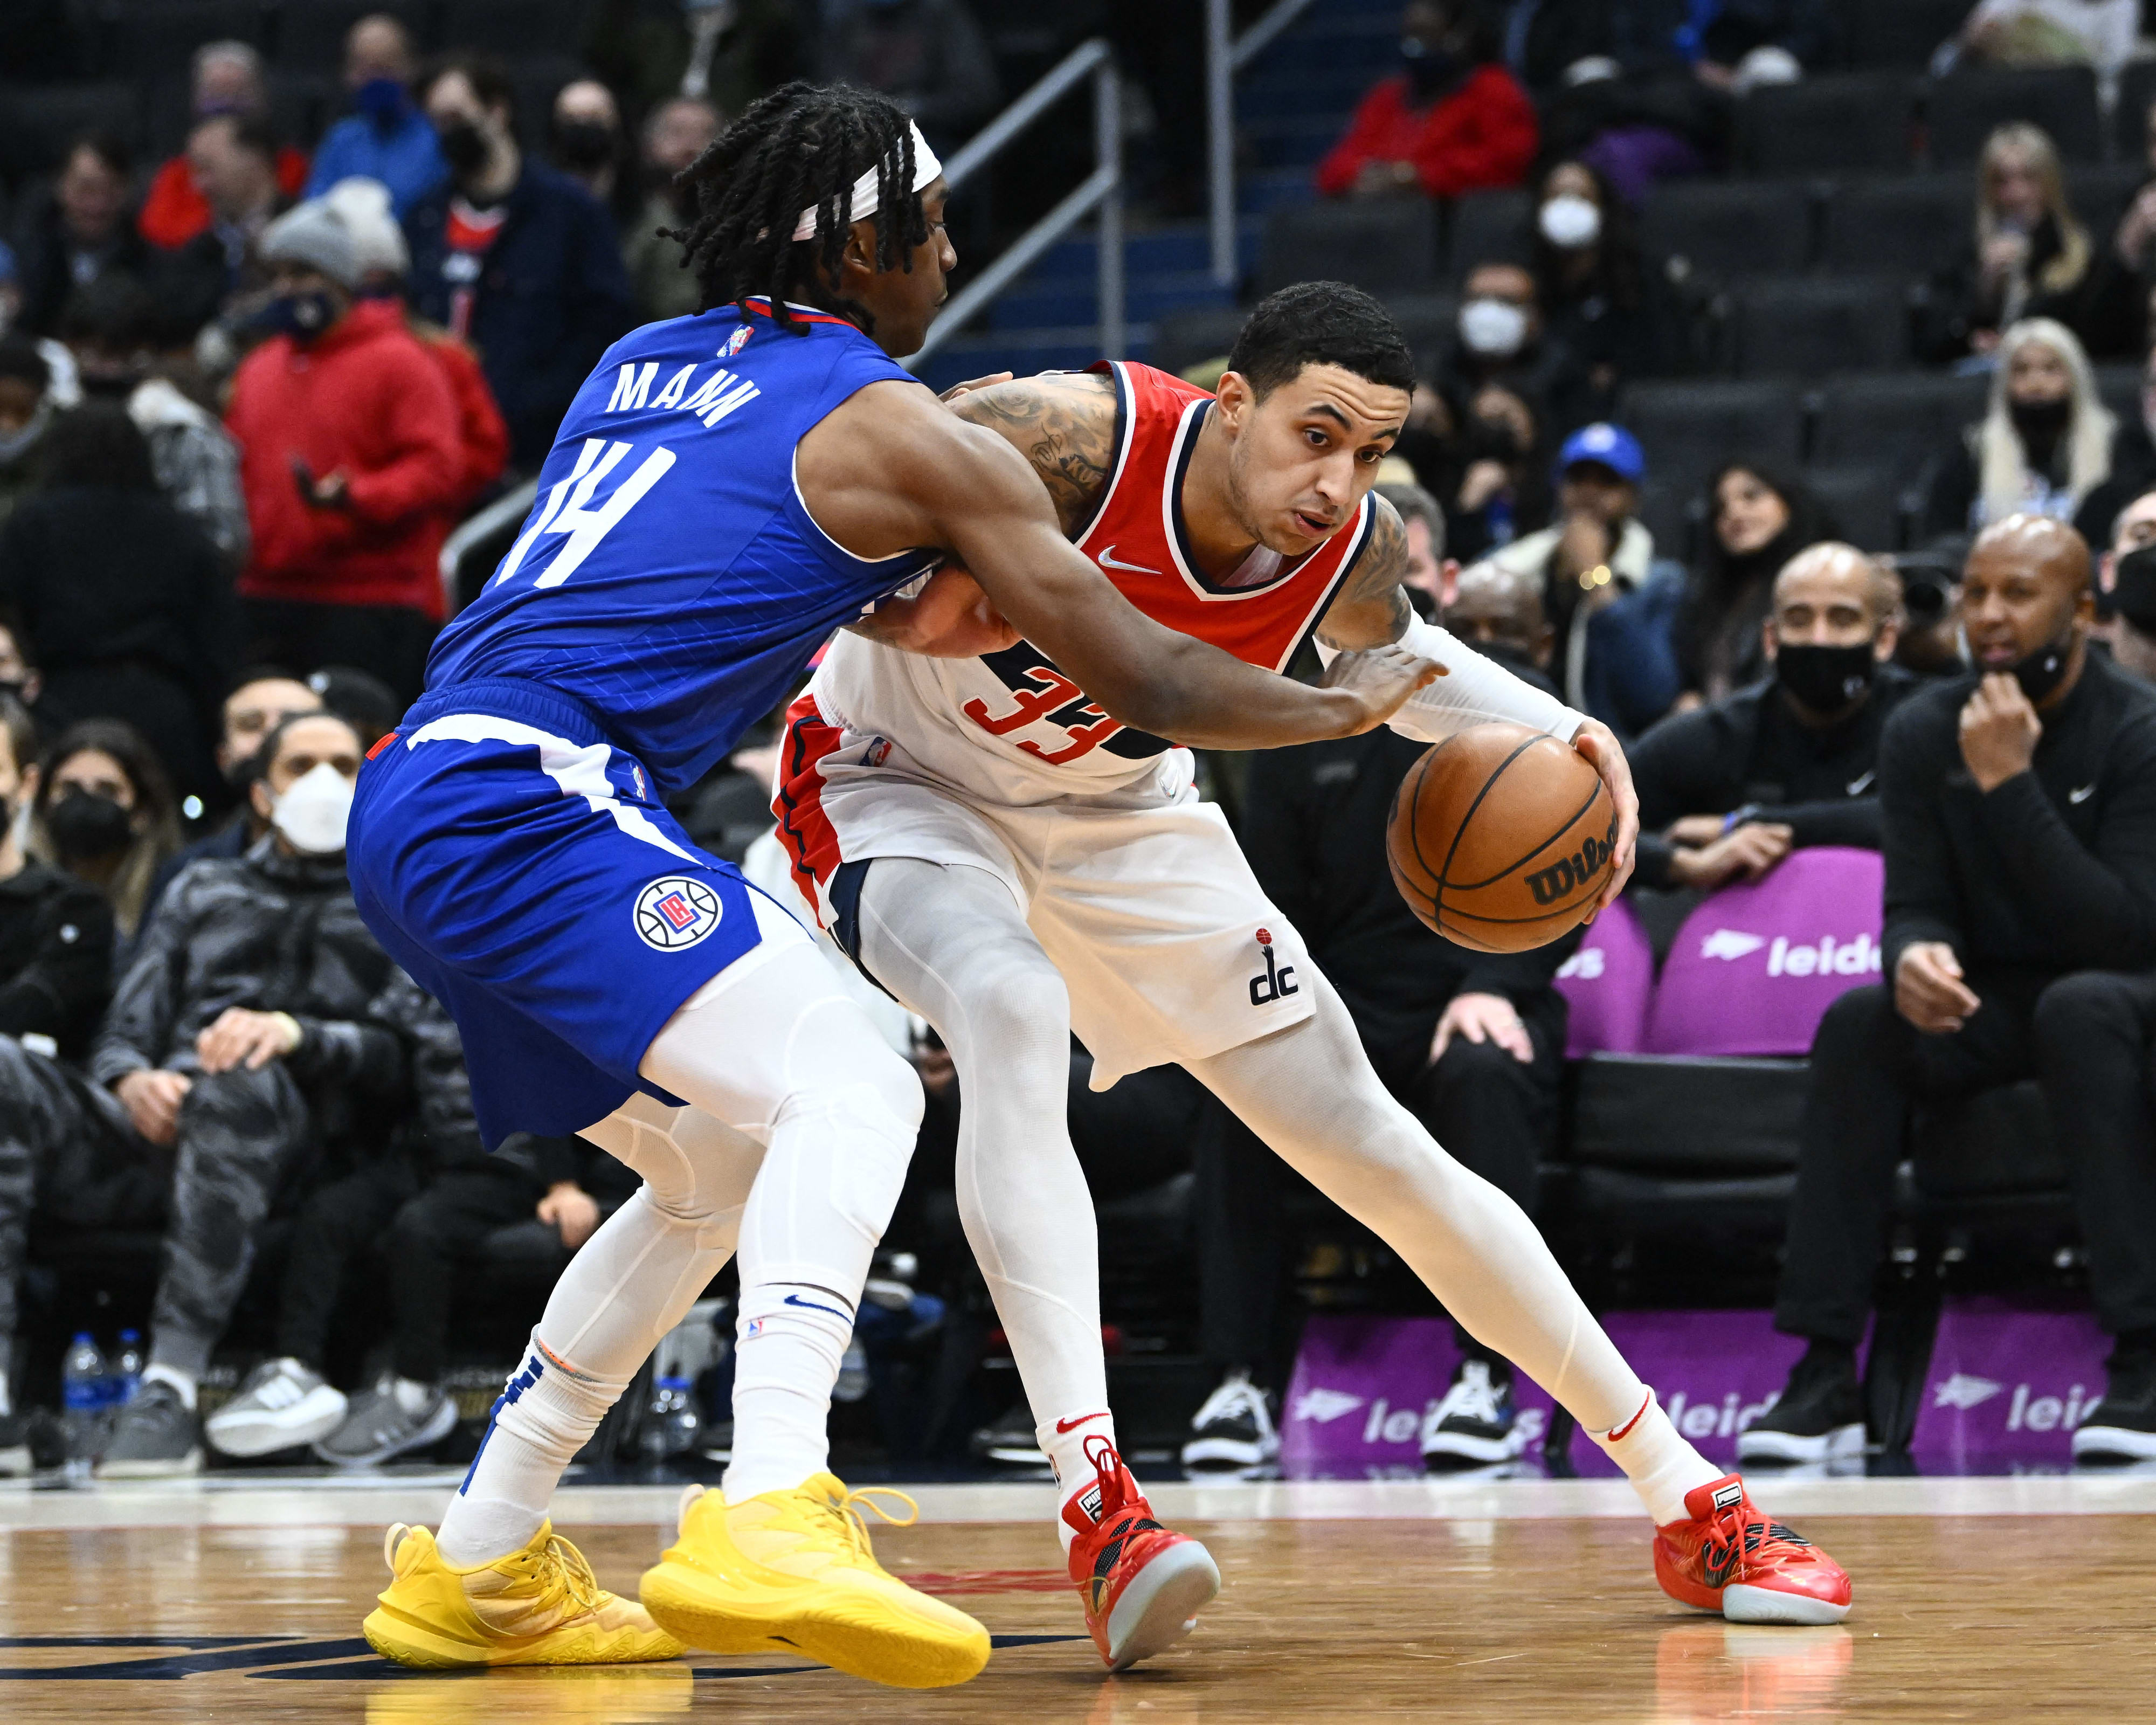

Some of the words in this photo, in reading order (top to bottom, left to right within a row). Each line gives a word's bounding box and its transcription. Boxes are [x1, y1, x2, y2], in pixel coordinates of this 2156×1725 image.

[605, 362, 761, 428] MANN
[495, 438, 677, 589] 14
[2008, 1384, 2102, 1432] lei
